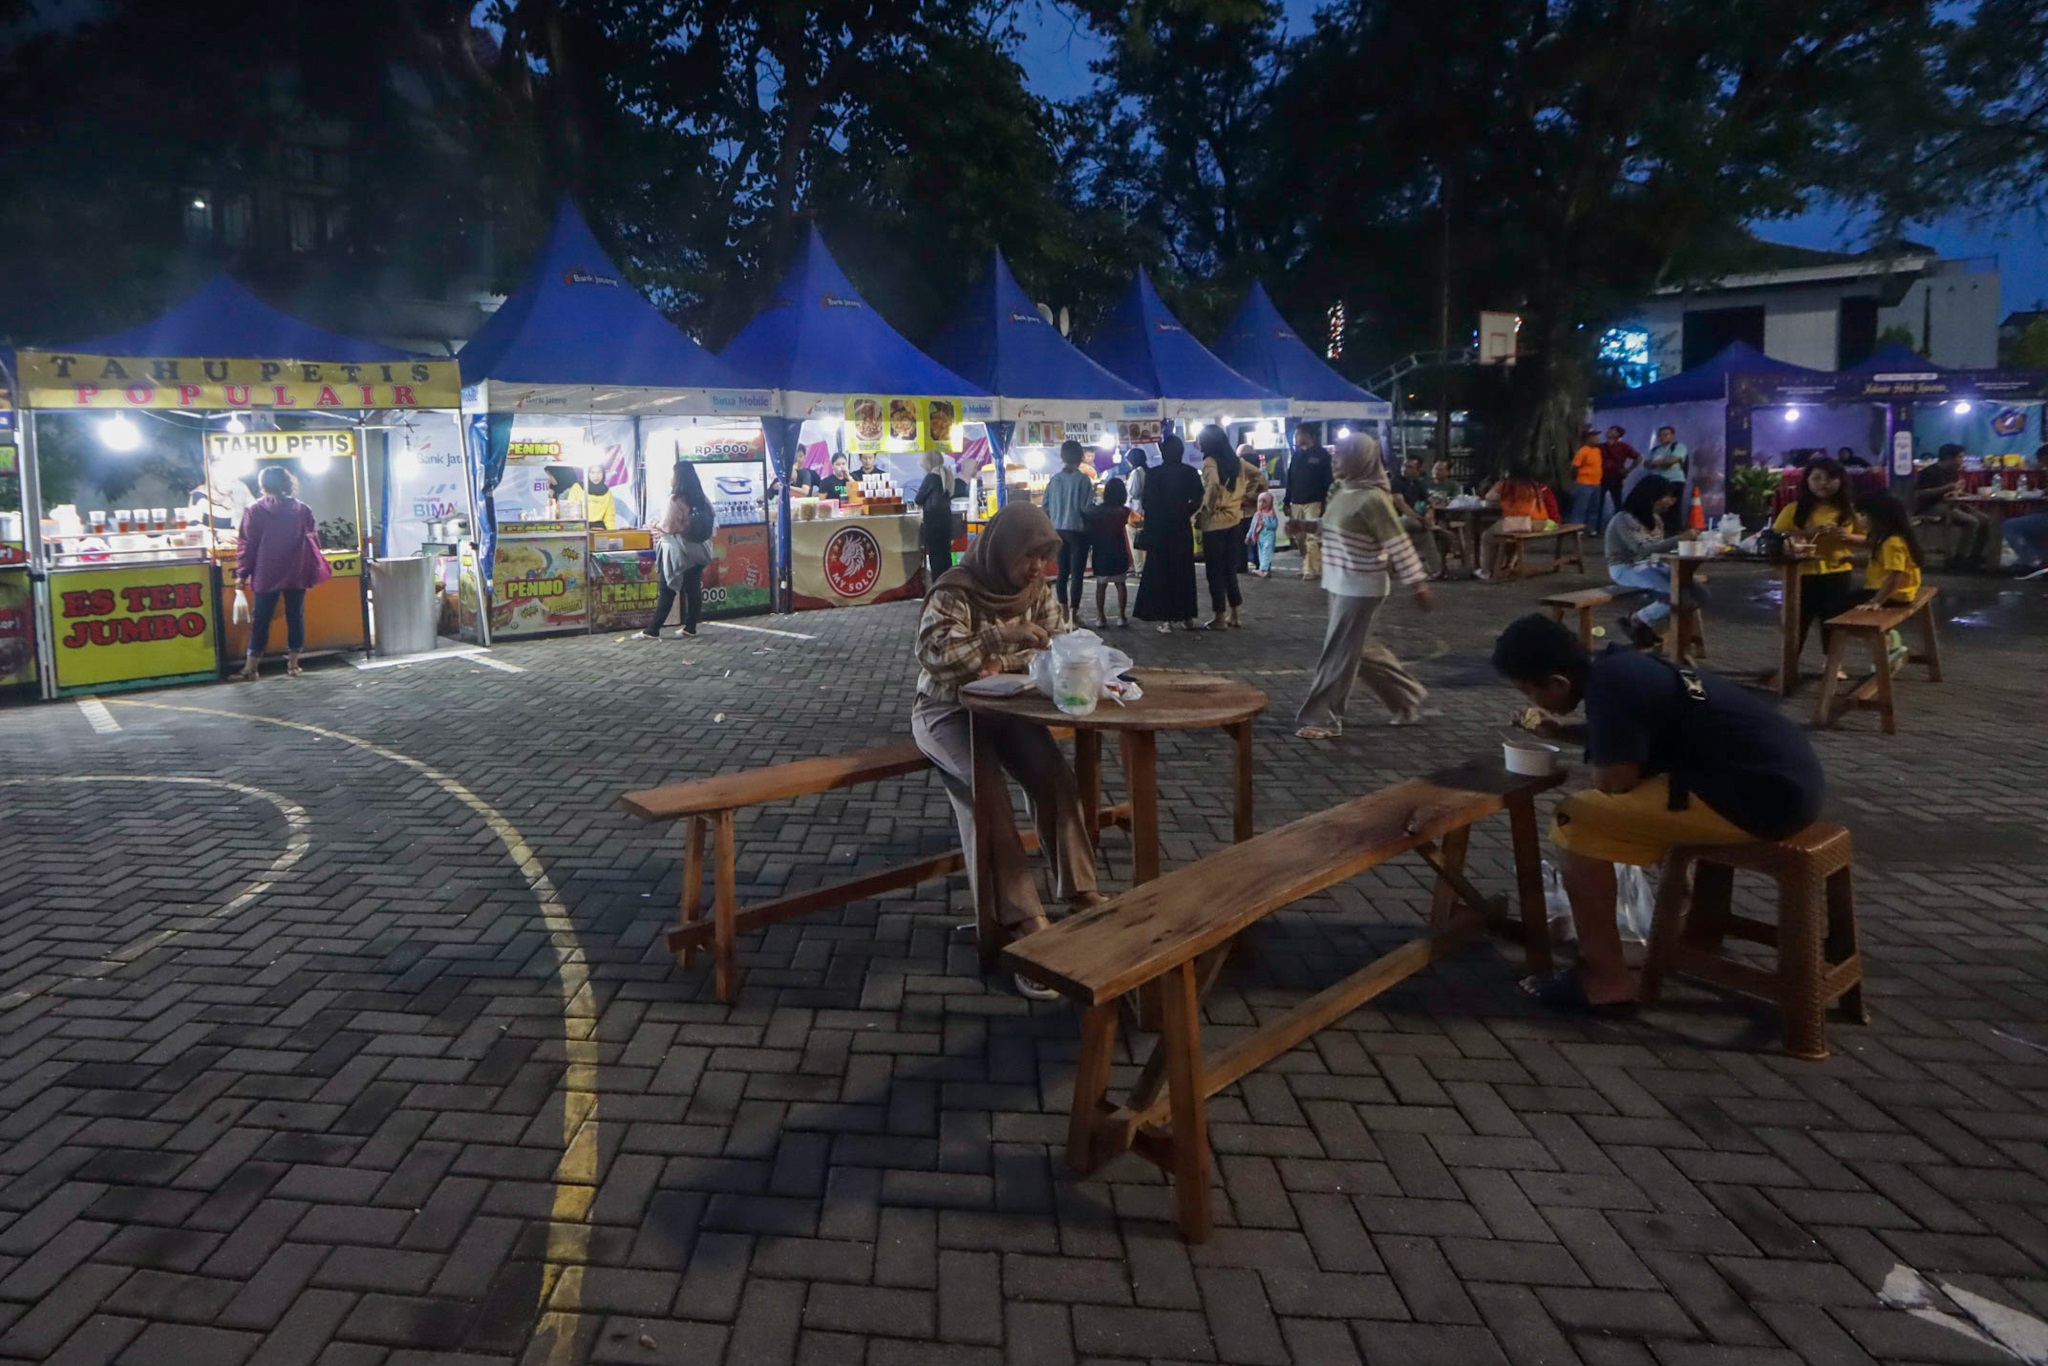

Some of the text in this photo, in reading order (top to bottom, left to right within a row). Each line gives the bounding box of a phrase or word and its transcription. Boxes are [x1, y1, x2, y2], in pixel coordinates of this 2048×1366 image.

[51, 356, 430, 383] TAHU PETIS
[74, 383, 418, 408] POPULAIR
[739, 395, 769, 407] Mobile
[214, 434, 349, 455] TAHU PETIS
[508, 443, 560, 456] PENMO
[695, 444, 748, 456] Rp.5000
[417, 452, 444, 464] Bank
[413, 502, 456, 518] BIMA
[508, 579, 564, 599] PENMO
[832, 569, 874, 592] MY SOLO
[62, 582, 203, 618] ES TEH
[601, 582, 658, 602] PENM
[63, 612, 206, 648] JUMBO
